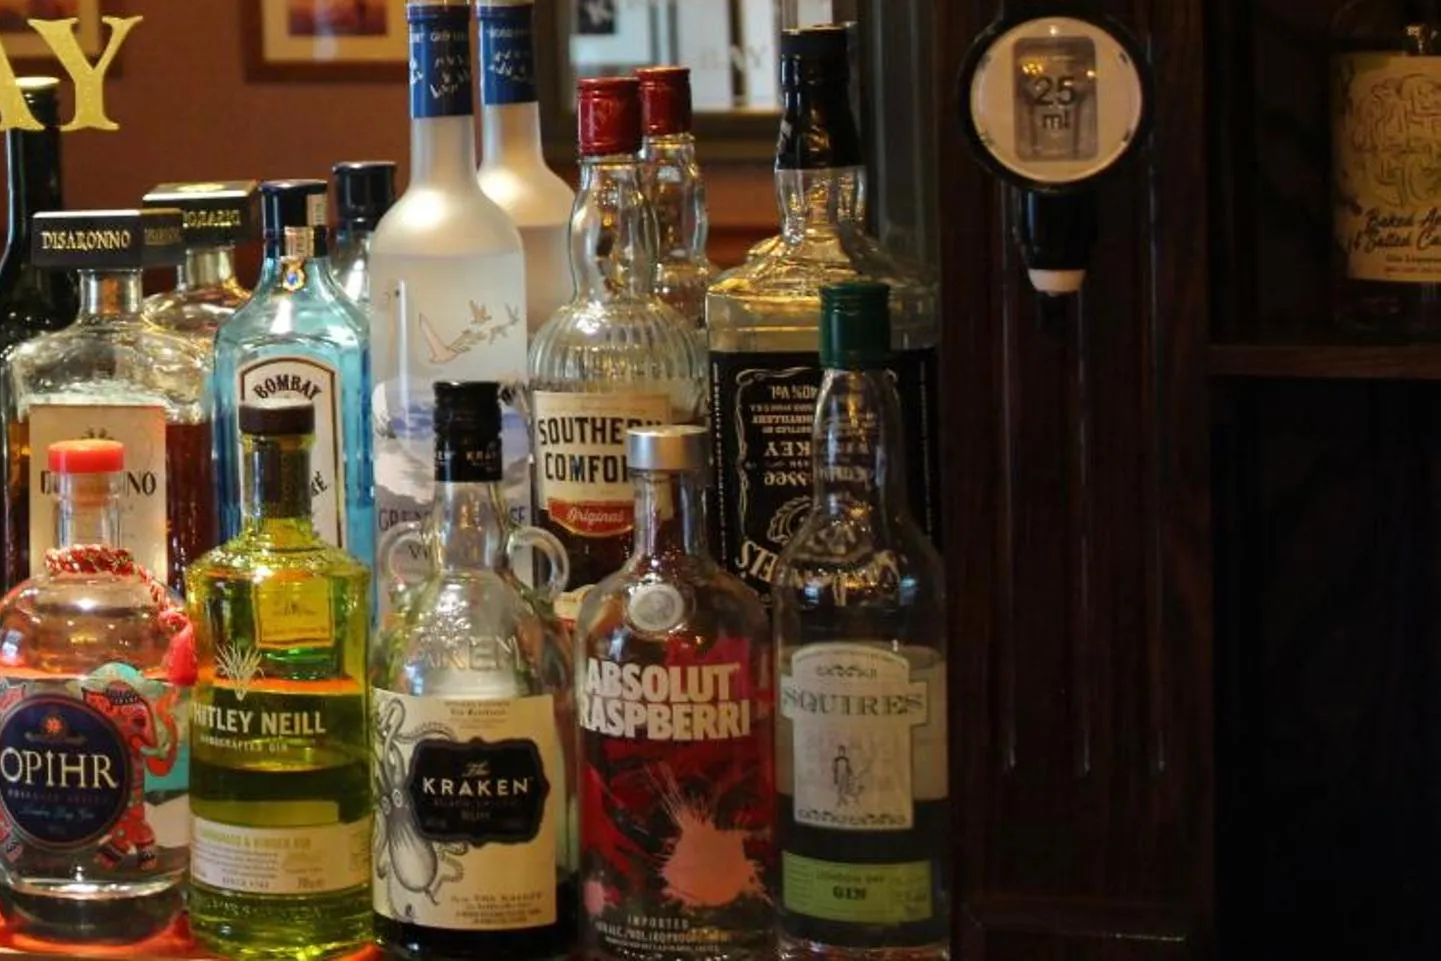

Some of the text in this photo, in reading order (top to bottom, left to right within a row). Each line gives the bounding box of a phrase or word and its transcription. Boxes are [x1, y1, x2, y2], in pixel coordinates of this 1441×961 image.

[1033, 76, 1077, 107] 25
[40, 228, 132, 250] DISARONNO
[253, 374, 323, 401] BOMBAY
[538, 417, 662, 446] SOUTHE
[545, 453, 628, 484] COMFO
[587, 657, 740, 703] ABSOLUT
[783, 686, 925, 716] SQUIRES
[261, 710, 327, 736] NEILL
[578, 697, 750, 741] RASPBERRI
[0, 745, 120, 790] OPIHR
[422, 776, 529, 797] KRAKEN
[832, 885, 867, 900] GIN
